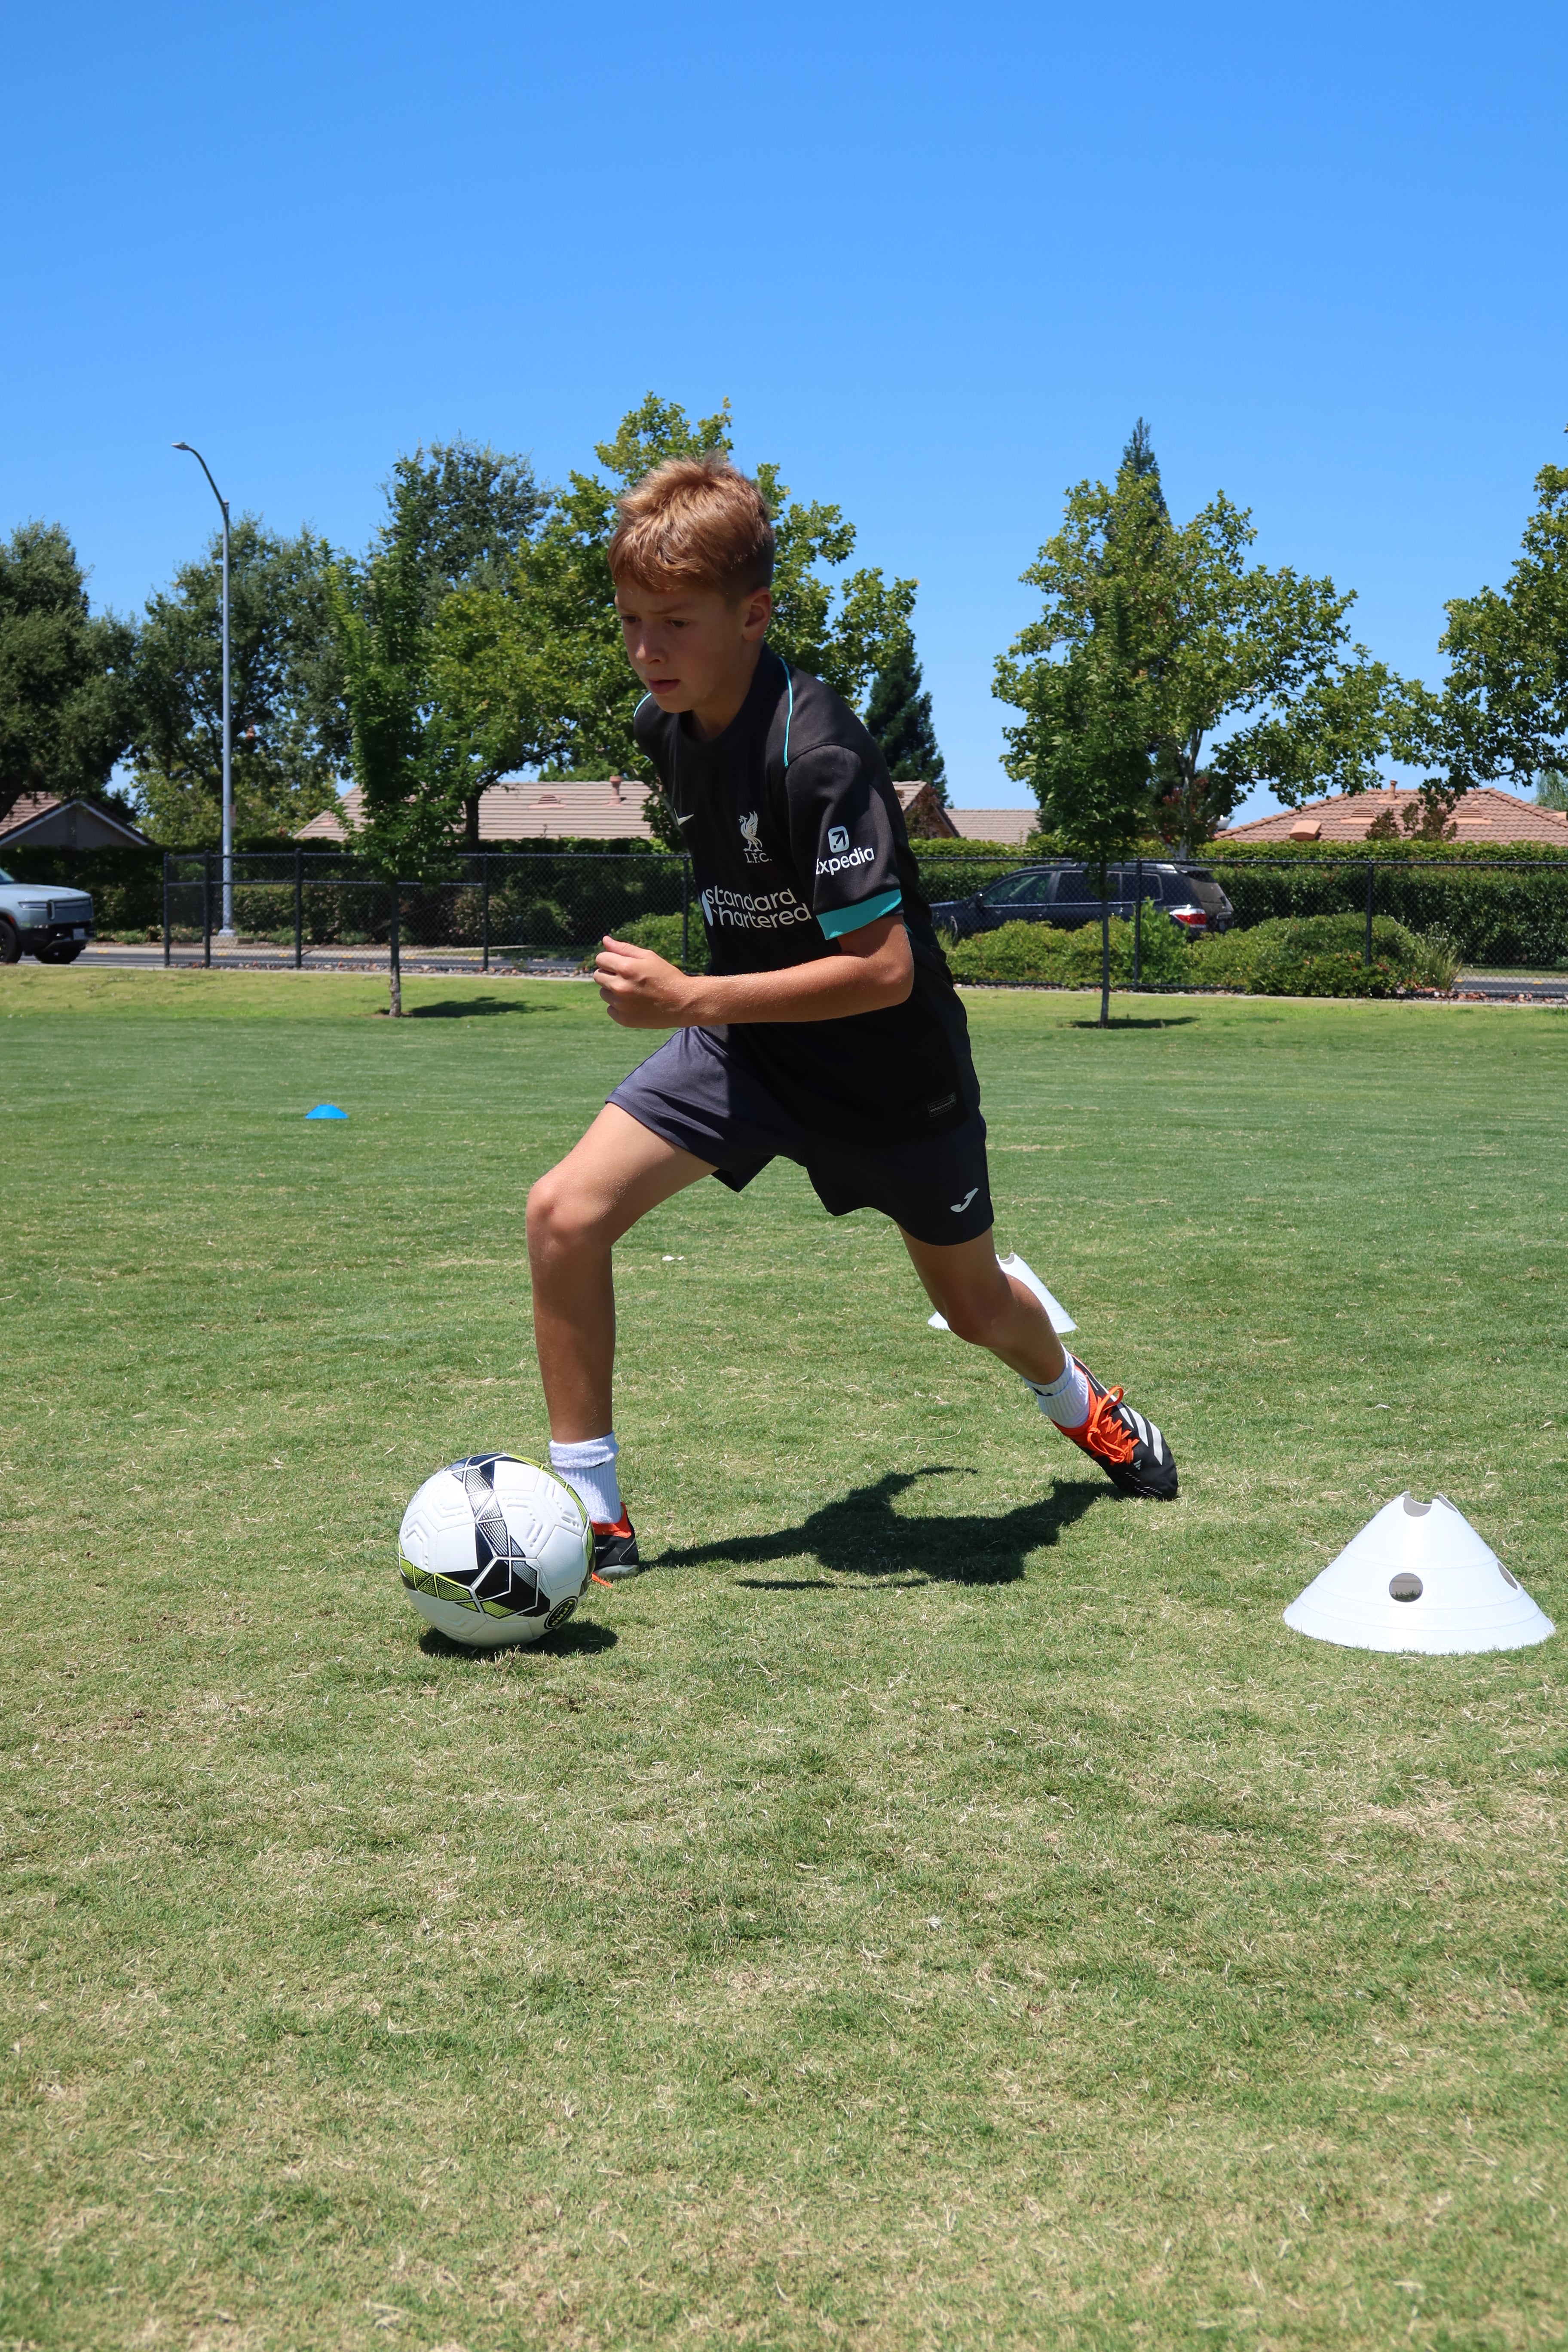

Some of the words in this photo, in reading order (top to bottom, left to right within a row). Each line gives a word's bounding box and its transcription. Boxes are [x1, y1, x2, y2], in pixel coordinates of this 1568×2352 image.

[745, 852, 772, 863] L.F.C.
[705, 885, 797, 912] standard
[713, 903, 812, 928] hartered
